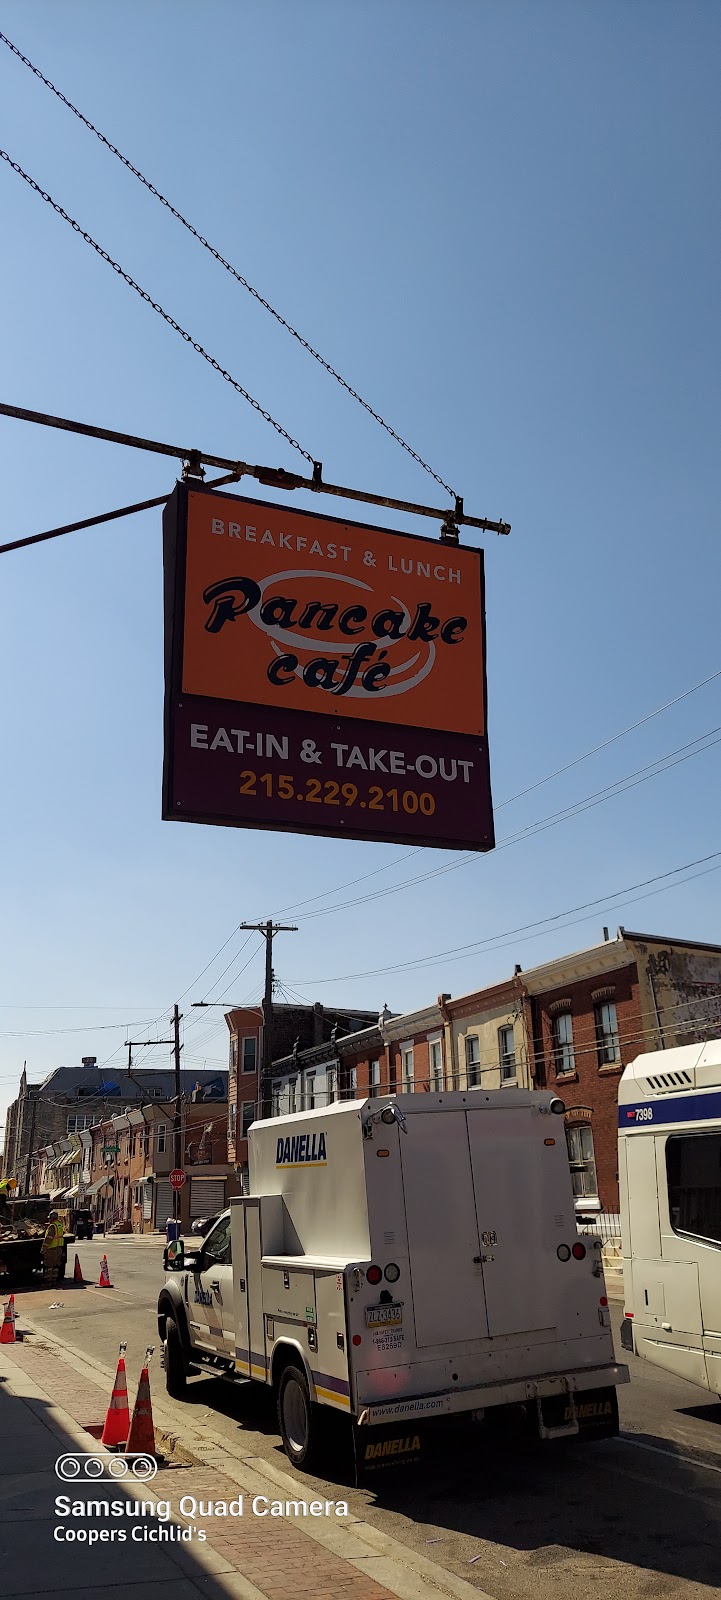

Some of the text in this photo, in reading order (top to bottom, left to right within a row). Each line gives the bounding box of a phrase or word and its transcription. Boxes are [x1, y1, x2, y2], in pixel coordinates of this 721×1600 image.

[211, 518, 462, 585] BREAKFAST & LUNCH
[203, 576, 468, 645] Pancake
[266, 641, 392, 696] café
[190, 723, 474, 784] EAT-IN & TAKE-OUT
[239, 770, 436, 816] 215.229.2100
[635, 1107, 653, 1121] 7398
[276, 1132, 327, 1164] DANELLA
[170, 1174, 185, 1182] STOP
[372, 1399, 444, 1418] www.danella.com
[563, 1401, 612, 1421] DNELLA
[364, 1435, 421, 1460] DANELLA
